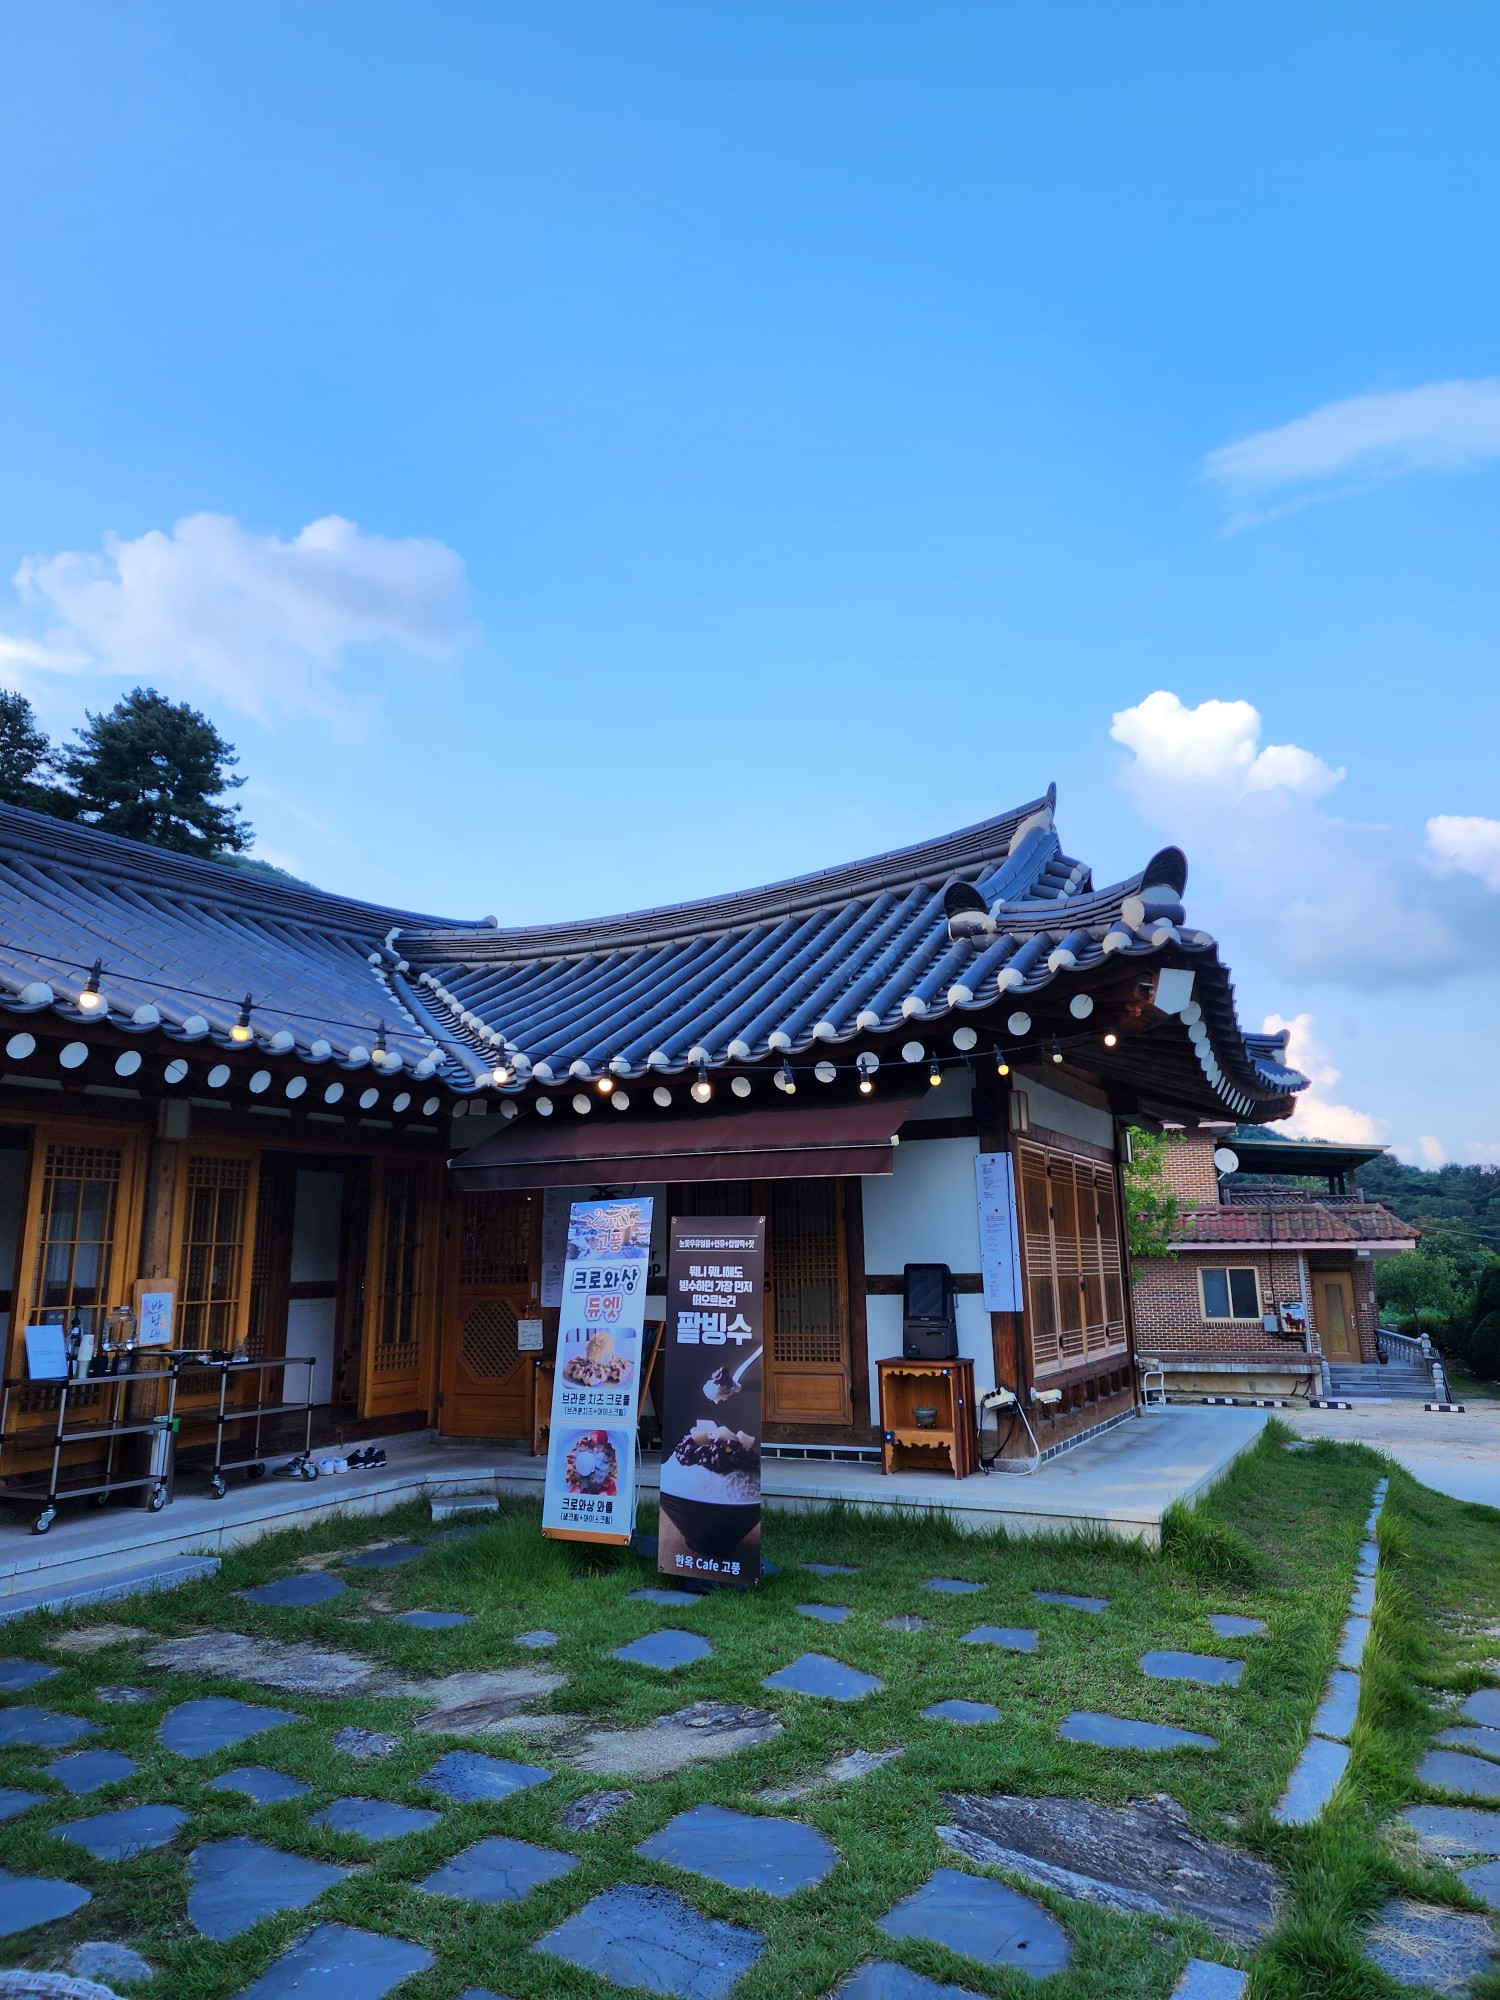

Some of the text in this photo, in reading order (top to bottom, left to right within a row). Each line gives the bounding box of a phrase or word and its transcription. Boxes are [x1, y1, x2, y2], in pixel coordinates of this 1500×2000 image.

[595, 1232, 622, 1251] 고풍
[573, 1268, 638, 1291] 크로와상
[689, 1265, 743, 1278] 뭐니 뭐니해도
[679, 1279, 753, 1293] 빙수하면 가장 먼저
[587, 1296, 621, 1319] 듀엣
[692, 1293, 737, 1307] 떠오르는건
[676, 1311, 753, 1346] 팔빙수
[562, 1393, 630, 1406] 브라운 치즈 크로플
[561, 1498, 613, 1513] 크로와상 와플
[675, 1553, 741, 1575] 한옥 Cafe 고풍
